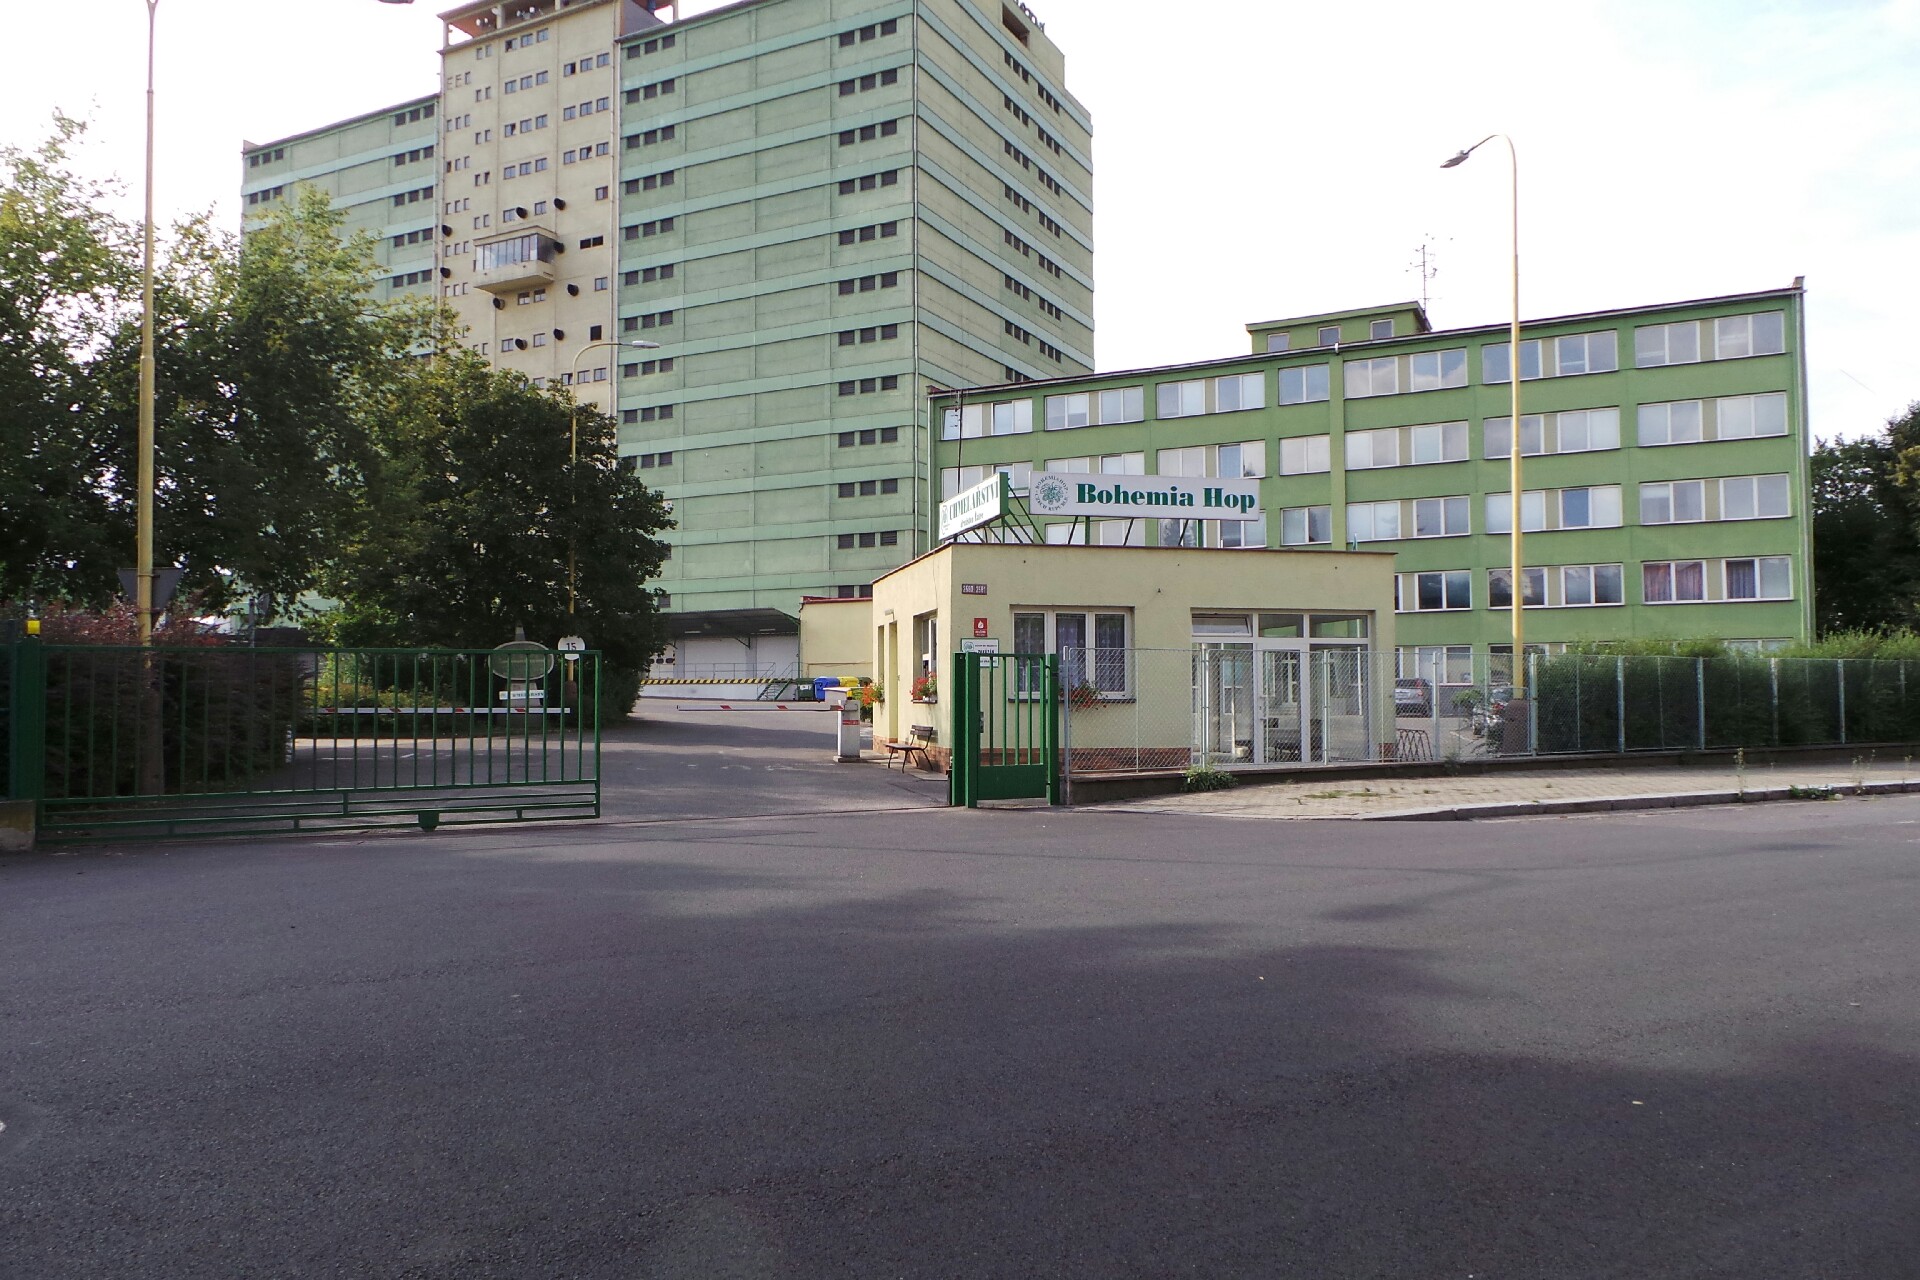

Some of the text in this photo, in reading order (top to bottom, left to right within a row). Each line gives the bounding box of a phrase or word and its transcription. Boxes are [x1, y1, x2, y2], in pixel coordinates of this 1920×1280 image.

[949, 475, 999, 520] CHMELAŘSTVÍ
[1075, 483, 1256, 514] Bohemia Hop
[566, 642, 577, 651] 15
